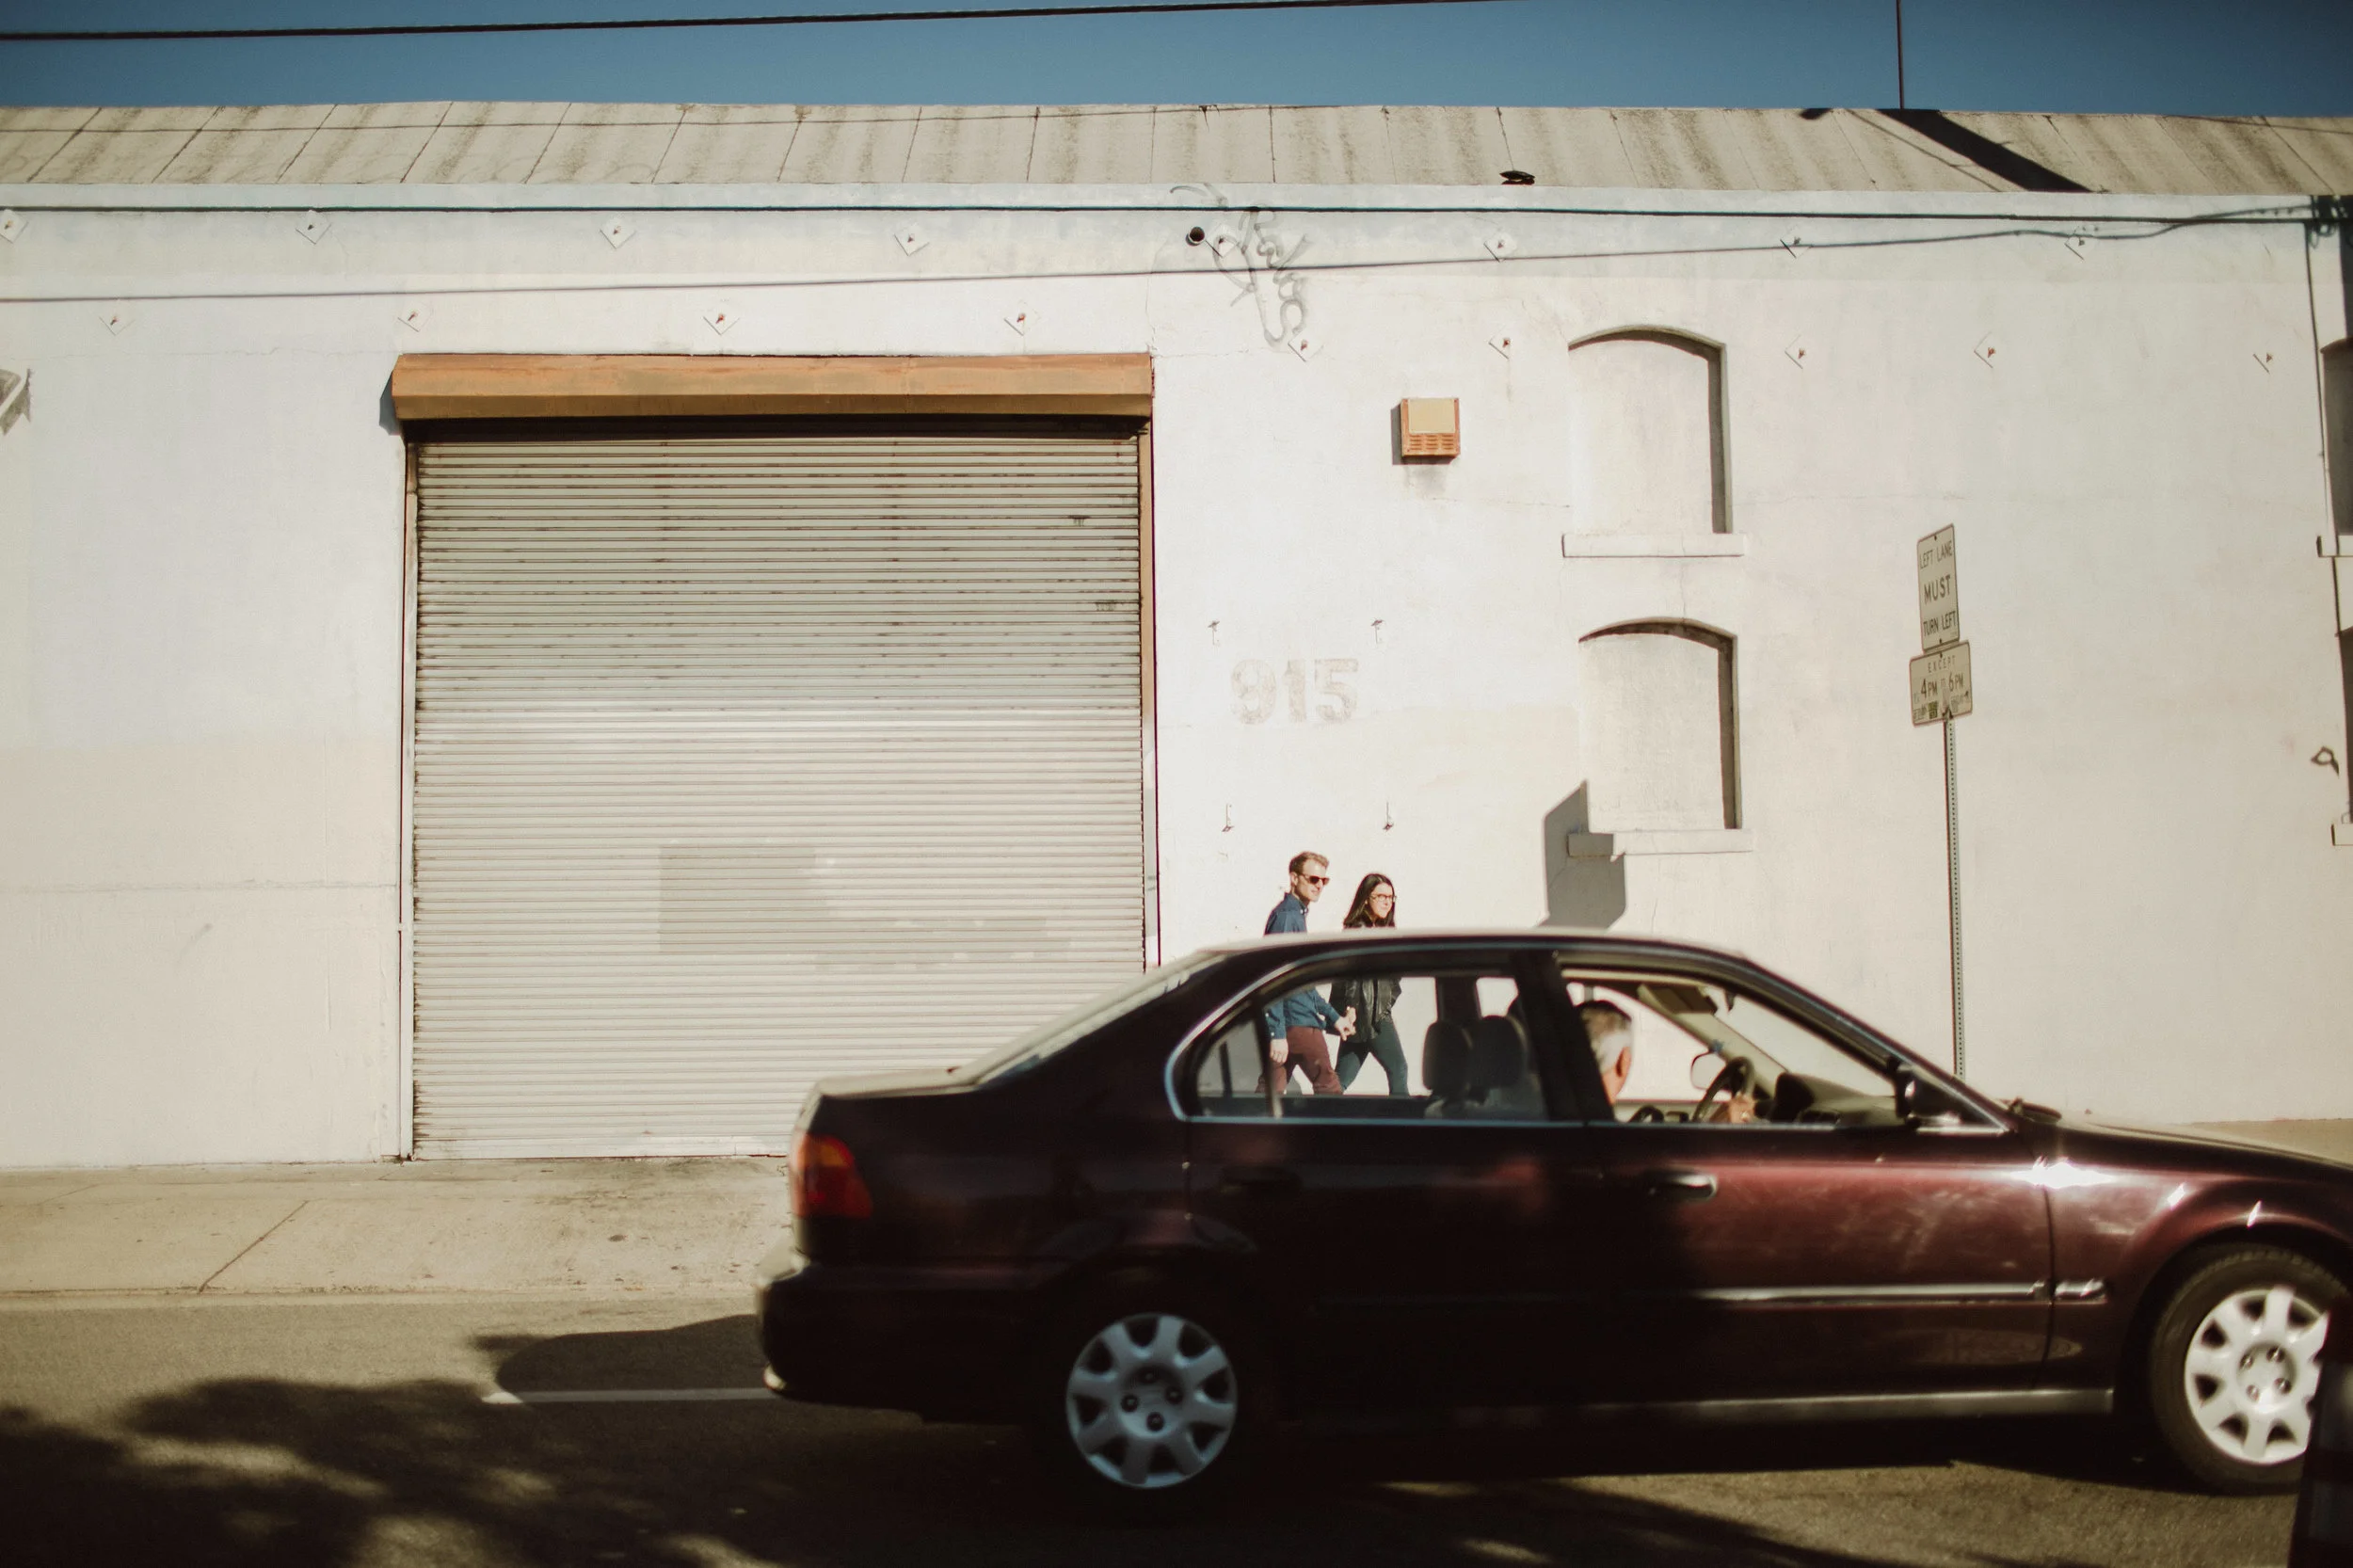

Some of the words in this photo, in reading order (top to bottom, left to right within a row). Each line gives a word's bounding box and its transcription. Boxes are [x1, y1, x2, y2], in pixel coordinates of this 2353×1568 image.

[1920, 550, 1933, 569] LEFT
[1936, 540, 1953, 562] LANE
[1924, 574, 1951, 604] MUST
[1923, 617, 1939, 637] TURN
[1942, 611, 1957, 631] LEFT
[1928, 654, 1956, 673] EXCEPT
[1231, 658, 1358, 725] 915
